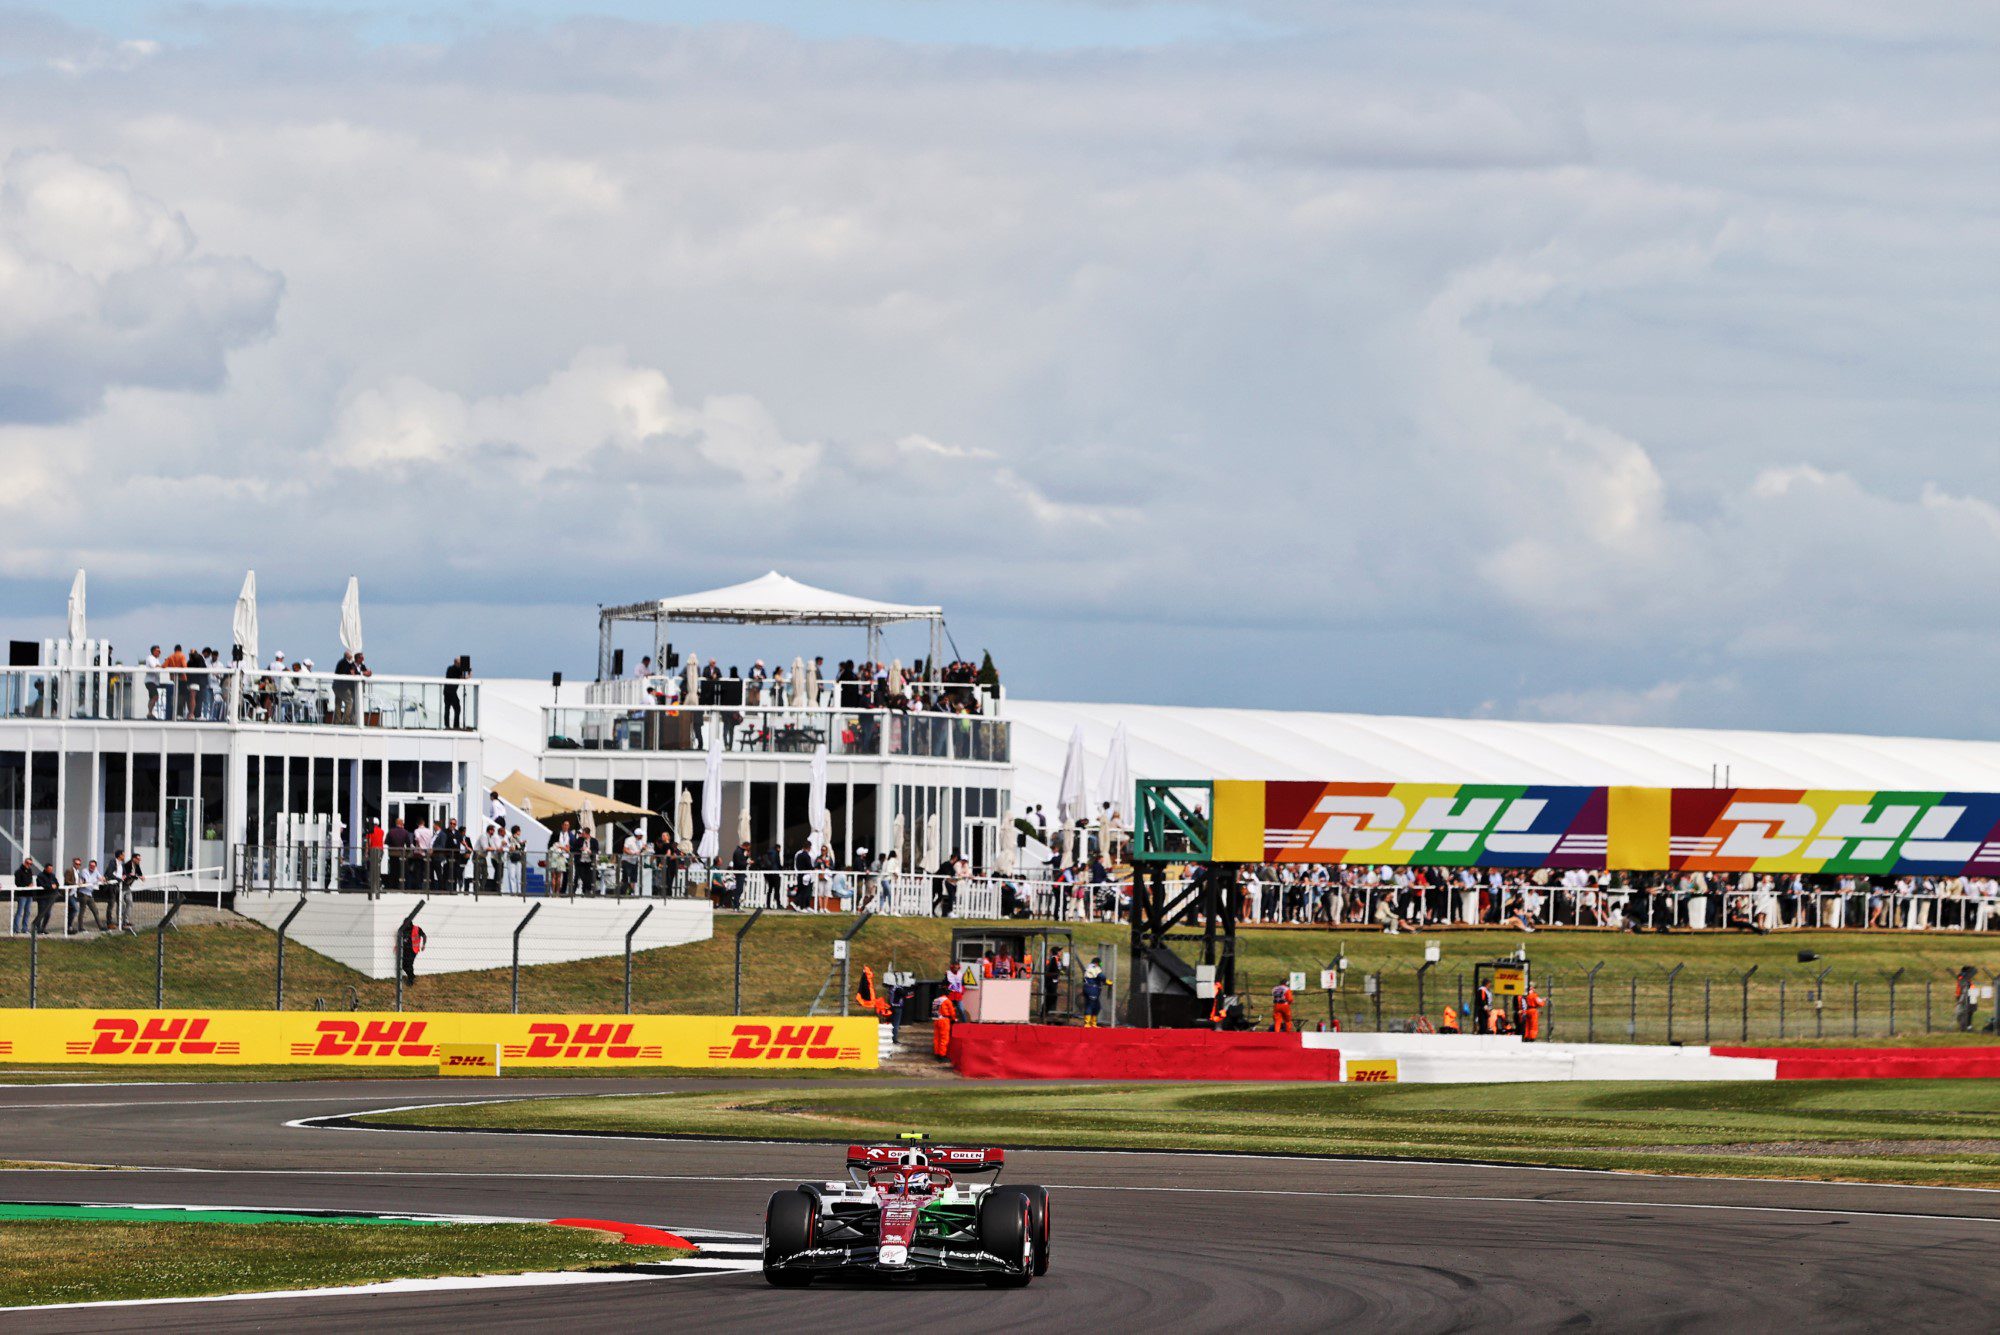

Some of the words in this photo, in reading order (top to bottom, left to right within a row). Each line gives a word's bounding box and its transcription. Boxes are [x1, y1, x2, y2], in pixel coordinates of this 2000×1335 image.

[1308, 796, 1563, 853] DHL
[1716, 803, 1981, 861] DHL
[91, 1018, 217, 1054] DHL
[314, 1021, 434, 1056] DHL
[527, 1023, 641, 1058] DHL
[731, 1025, 840, 1059] DHL
[449, 1055, 486, 1066] DHL
[1355, 1070, 1389, 1082] DHL
